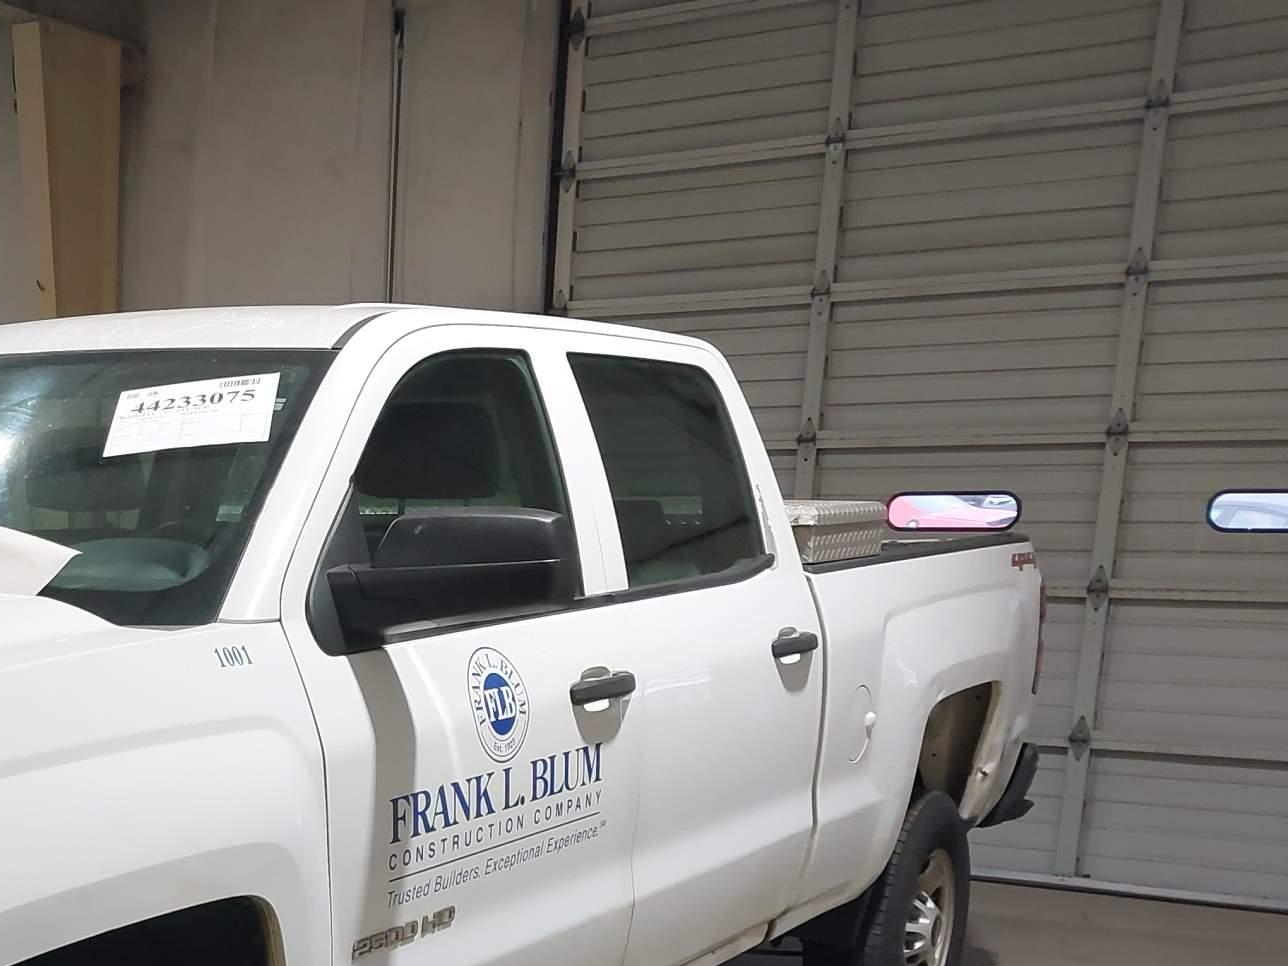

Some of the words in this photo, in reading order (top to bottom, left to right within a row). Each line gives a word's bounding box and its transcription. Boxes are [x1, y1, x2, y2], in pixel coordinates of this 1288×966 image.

[131, 388, 256, 415] 44233075
[214, 645, 253, 667] 1001
[472, 656, 487, 726] FRANK
[500, 659, 527, 715] BLUM
[483, 685, 516, 723] FLB
[390, 771, 496, 845] FRANK
[502, 767, 525, 811] L.
[530, 742, 602, 802] BLUM
[389, 814, 524, 871] CONSTRUCTION
[534, 788, 602, 825] COMPANY
[387, 882, 430, 909] Trusted
[433, 867, 481, 893] Builders.
[484, 845, 544, 876] Exceptional
[421, 905, 456, 938] HD
